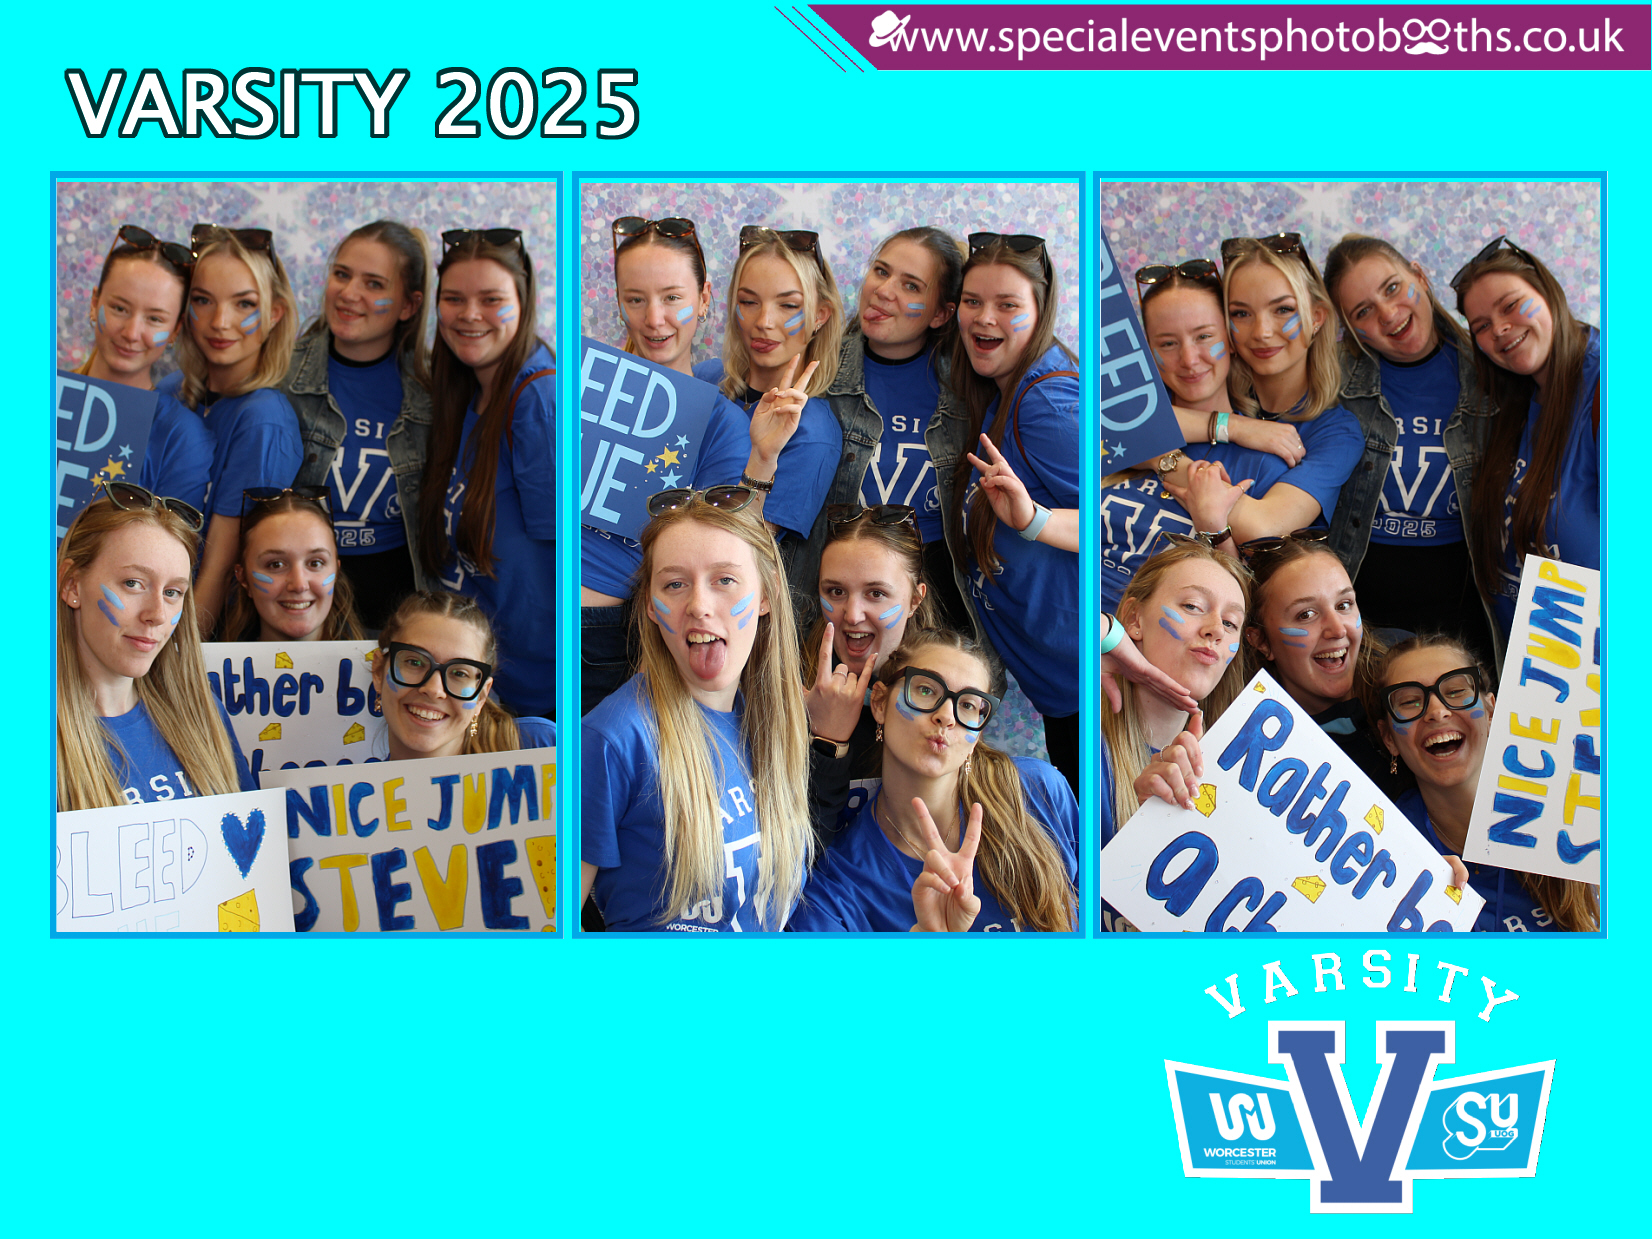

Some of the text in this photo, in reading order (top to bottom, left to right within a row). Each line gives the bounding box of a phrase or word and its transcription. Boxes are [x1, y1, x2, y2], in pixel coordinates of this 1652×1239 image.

[1519, 561, 1588, 703] JUMP
[286, 777, 412, 838] NICE
[1217, 698, 1396, 900] Rather
[1488, 712, 1561, 849] NICE
